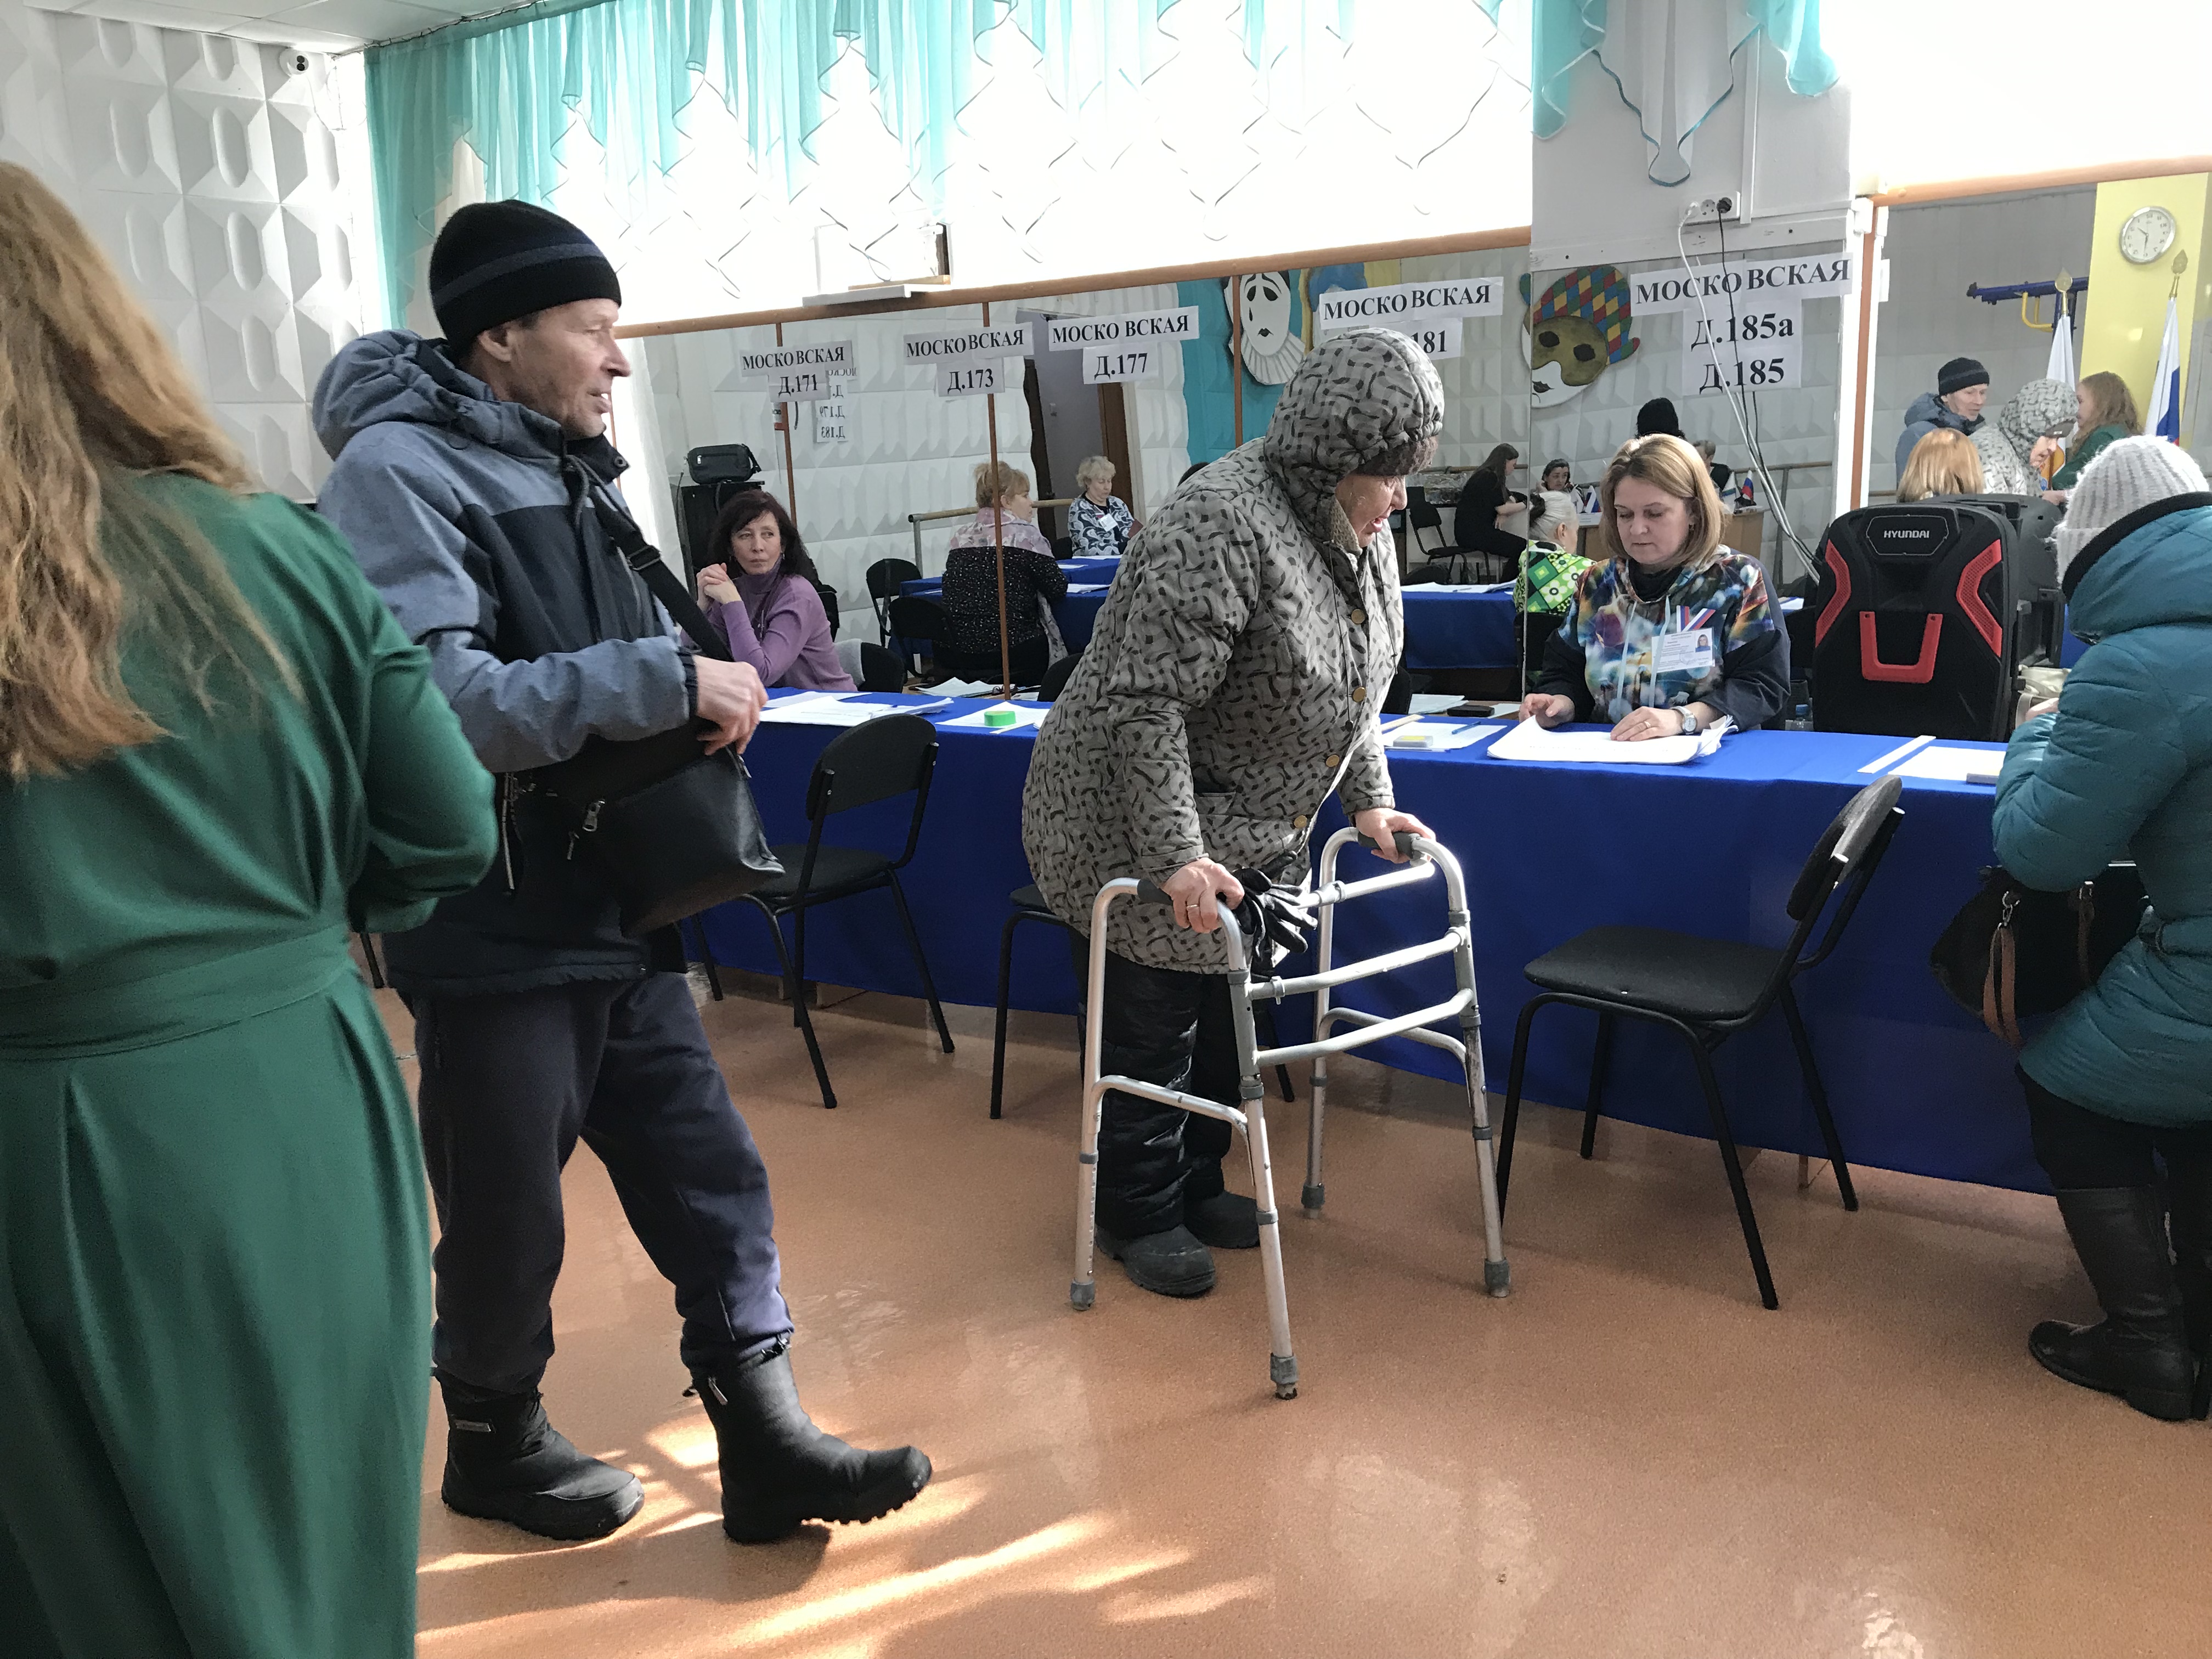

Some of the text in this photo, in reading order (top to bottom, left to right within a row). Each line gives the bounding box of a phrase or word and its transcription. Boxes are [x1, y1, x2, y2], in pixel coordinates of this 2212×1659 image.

[1635, 259, 1851, 304] МОСКОВСКАЯ
[1323, 285, 1491, 320] МОСКОВСКАЯ
[906, 329, 1024, 357] МОСКОВСКАЯ
[1052, 315, 1189, 343] МОСКОВСКАЯ
[1691, 313, 1795, 352] Д.185а
[742, 347, 845, 370] МОСКОВСКАЯ
[1094, 353, 1148, 381] Д.177
[778, 374, 818, 398] Д.171
[947, 368, 994, 394] Д.173
[1699, 358, 1784, 395] Д.185
[1884, 530, 1929, 538] HYUNDAI
